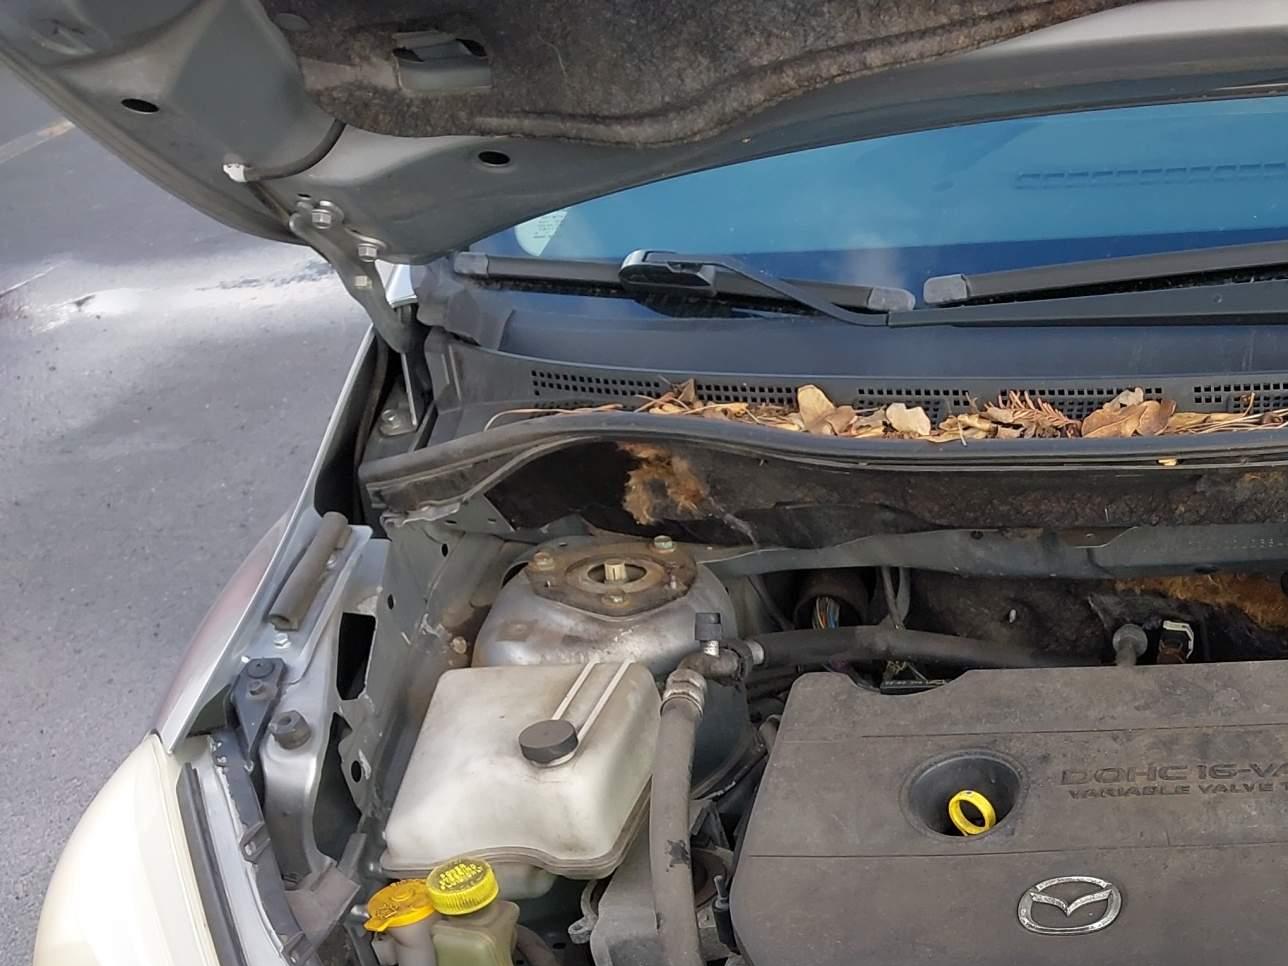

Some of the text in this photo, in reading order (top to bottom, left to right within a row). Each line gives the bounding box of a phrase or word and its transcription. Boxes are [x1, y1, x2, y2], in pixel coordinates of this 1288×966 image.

[1061, 765, 1188, 786] DOHC
[1068, 785, 1191, 800] VARIABLE
[1198, 782, 1274, 795] VALVE
